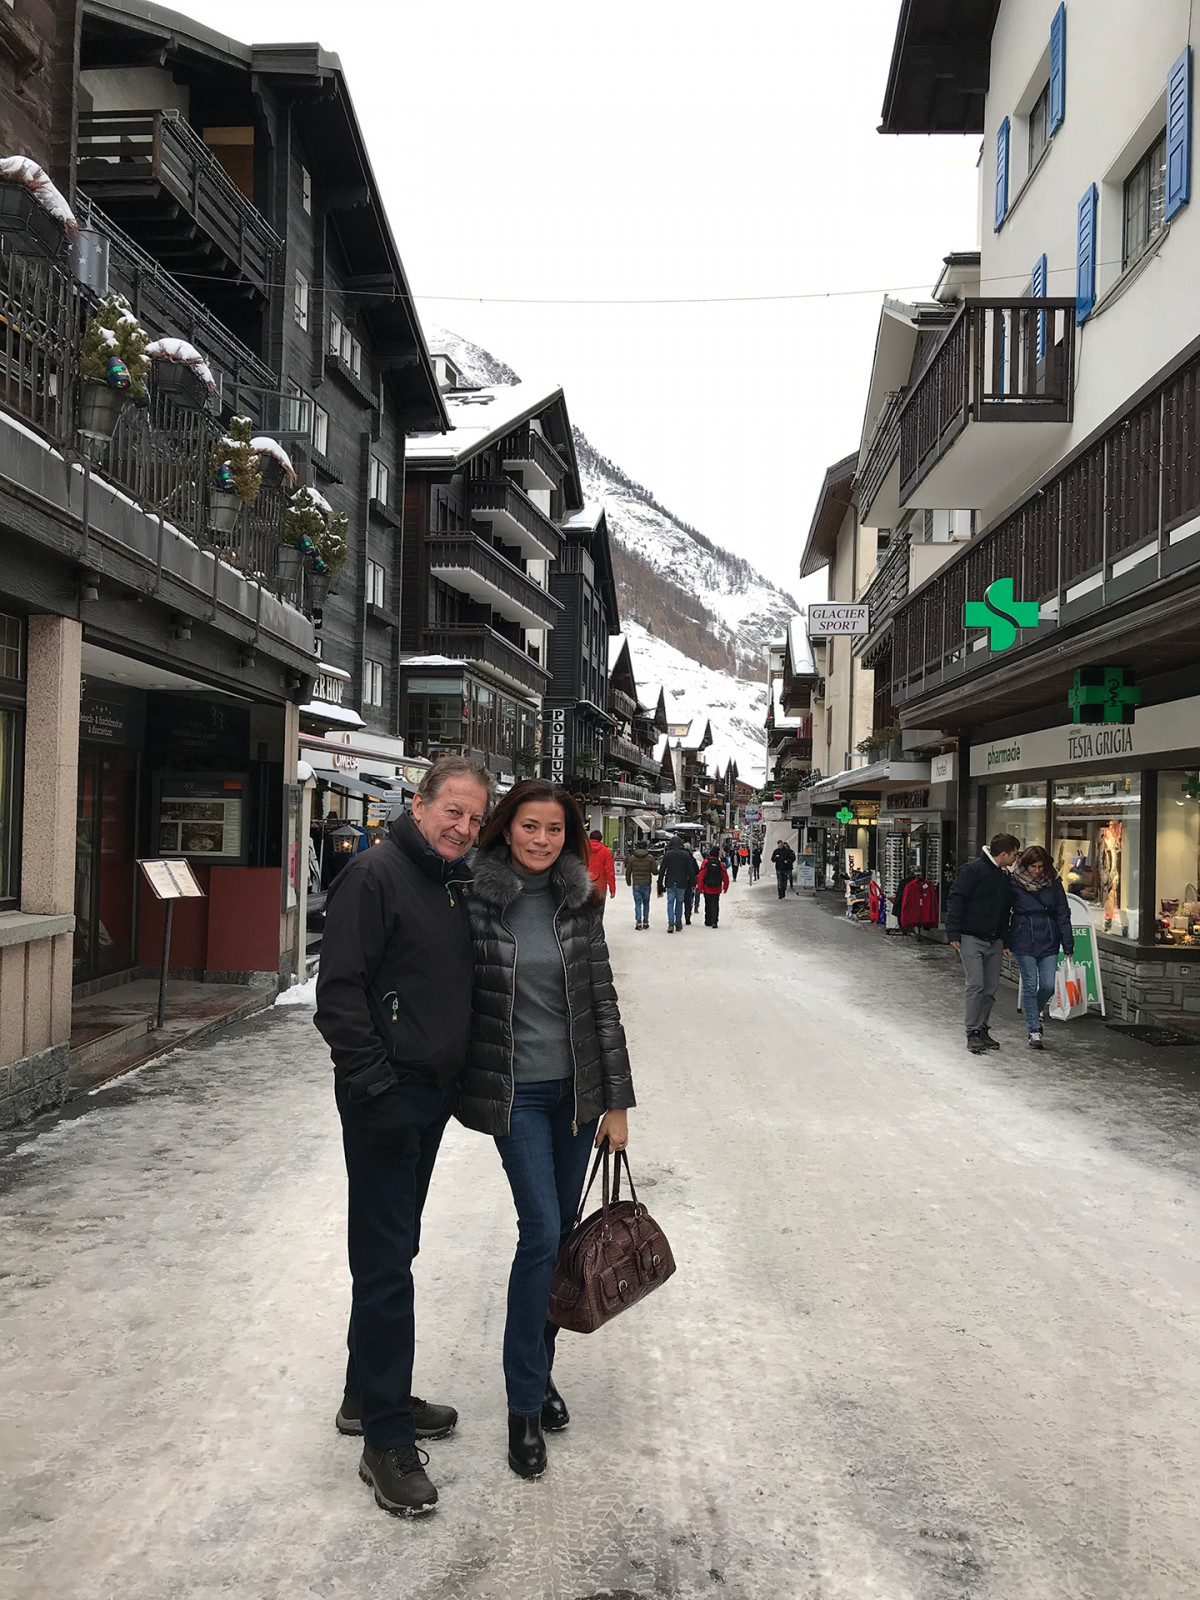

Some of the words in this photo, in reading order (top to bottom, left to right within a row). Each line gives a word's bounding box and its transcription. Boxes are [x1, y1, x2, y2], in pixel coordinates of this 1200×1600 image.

[812, 609, 866, 619] GLACIER
[819, 621, 858, 630] SPORT
[552, 710, 563, 783] POLLUX
[1067, 735, 1093, 759] TESTA
[1095, 727, 1133, 756] GRIGIA
[333, 753, 359, 769] OMEGA
[987, 741, 1021, 770] pharmacie
